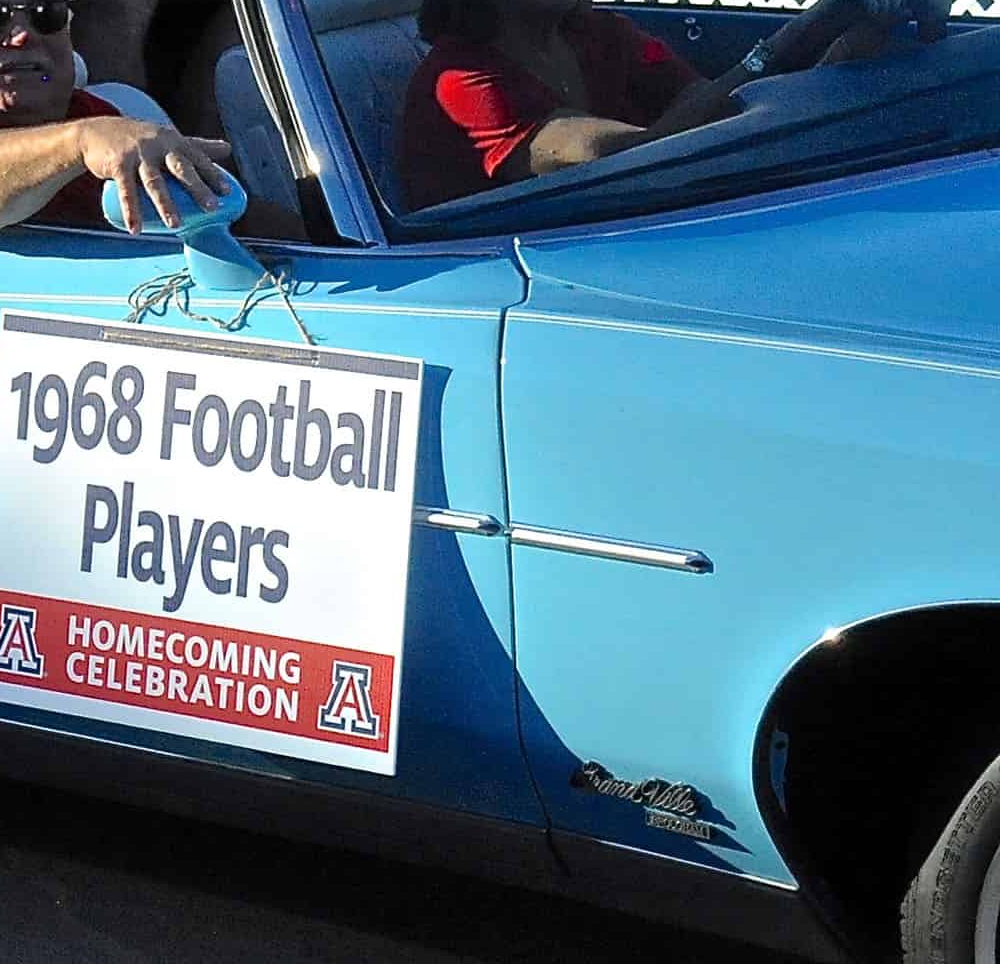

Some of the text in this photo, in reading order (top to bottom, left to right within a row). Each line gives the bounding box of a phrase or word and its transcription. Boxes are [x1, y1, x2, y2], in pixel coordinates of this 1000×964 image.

[10, 361, 403, 492] 1968 Football
[80, 481, 290, 612] Players
[65, 651, 299, 722] CELEBRATION
[67, 615, 301, 685] HOMECOMING
[317, 660, 381, 740] A
